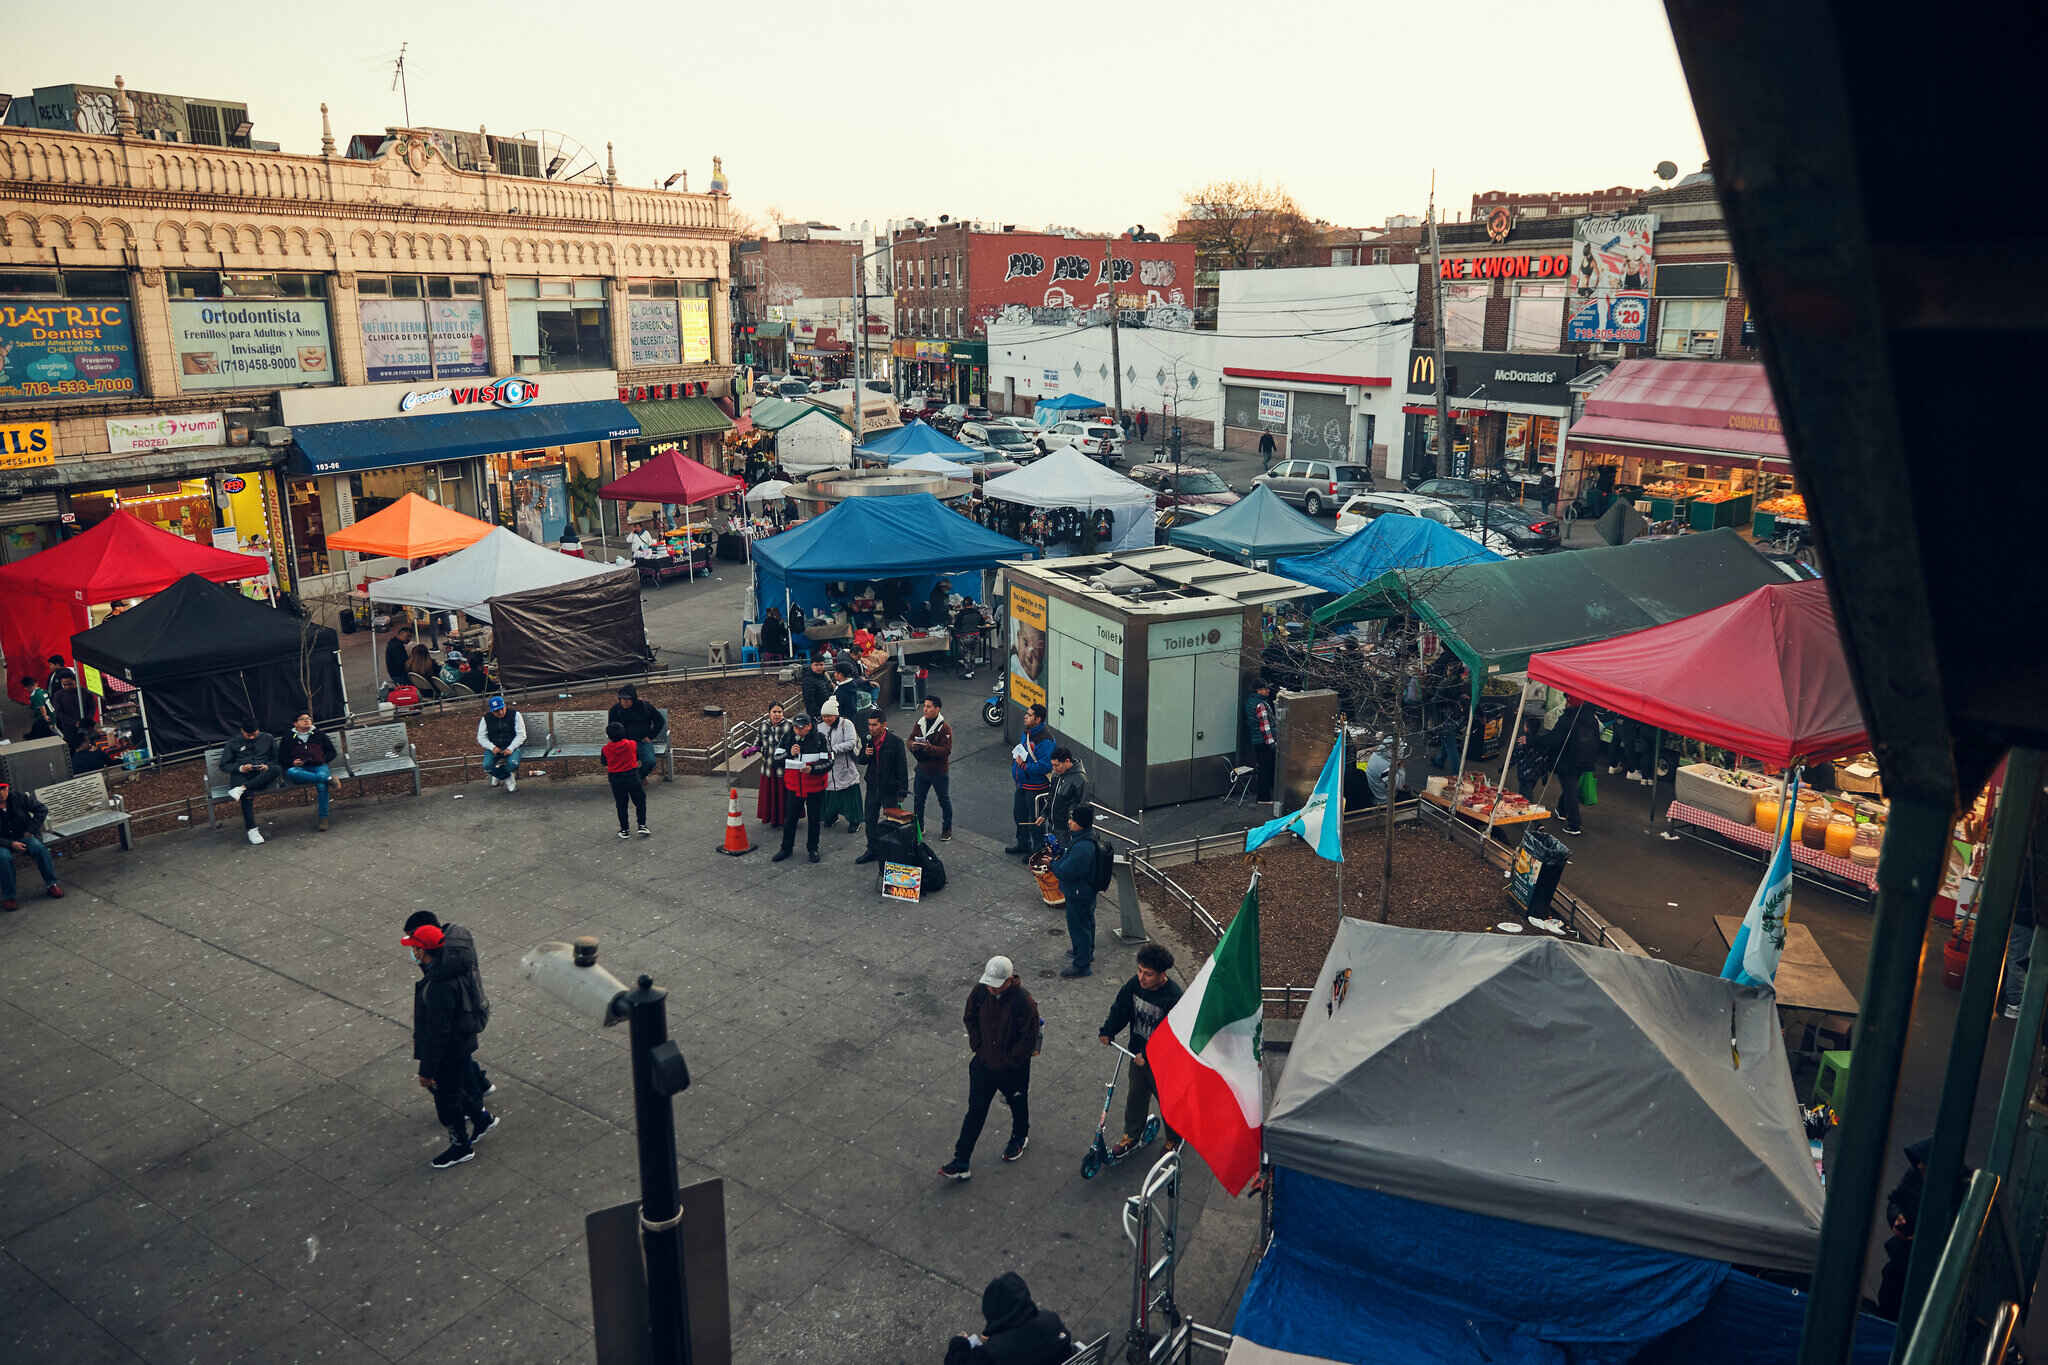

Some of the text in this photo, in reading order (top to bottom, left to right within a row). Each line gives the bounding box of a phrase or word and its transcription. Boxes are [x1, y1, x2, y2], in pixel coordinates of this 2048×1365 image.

[1440, 254, 1569, 279] AE KWON DO
[202, 308, 301, 324] Ortodontista
[32, 328, 102, 340] Dentist
[184, 329, 226, 340] Frenillos
[229, 330, 250, 340] para
[254, 328, 287, 338] Adultos
[368, 334, 400, 342] CLINICA
[231, 344, 283, 356] Invisalign
[1494, 369, 1554, 384] McDonald's
[23, 378, 134, 397] 718-533-7000
[453, 382, 540, 406] VISION
[617, 381, 710, 402] BAKERY
[1260, 398, 1285, 409] FOR LEASE
[132, 438, 168, 449] FROZEN
[268, 489, 289, 582] GRAND OPENING
[1097, 625, 1119, 645] Toilet
[1163, 636, 1200, 651] Toilet
